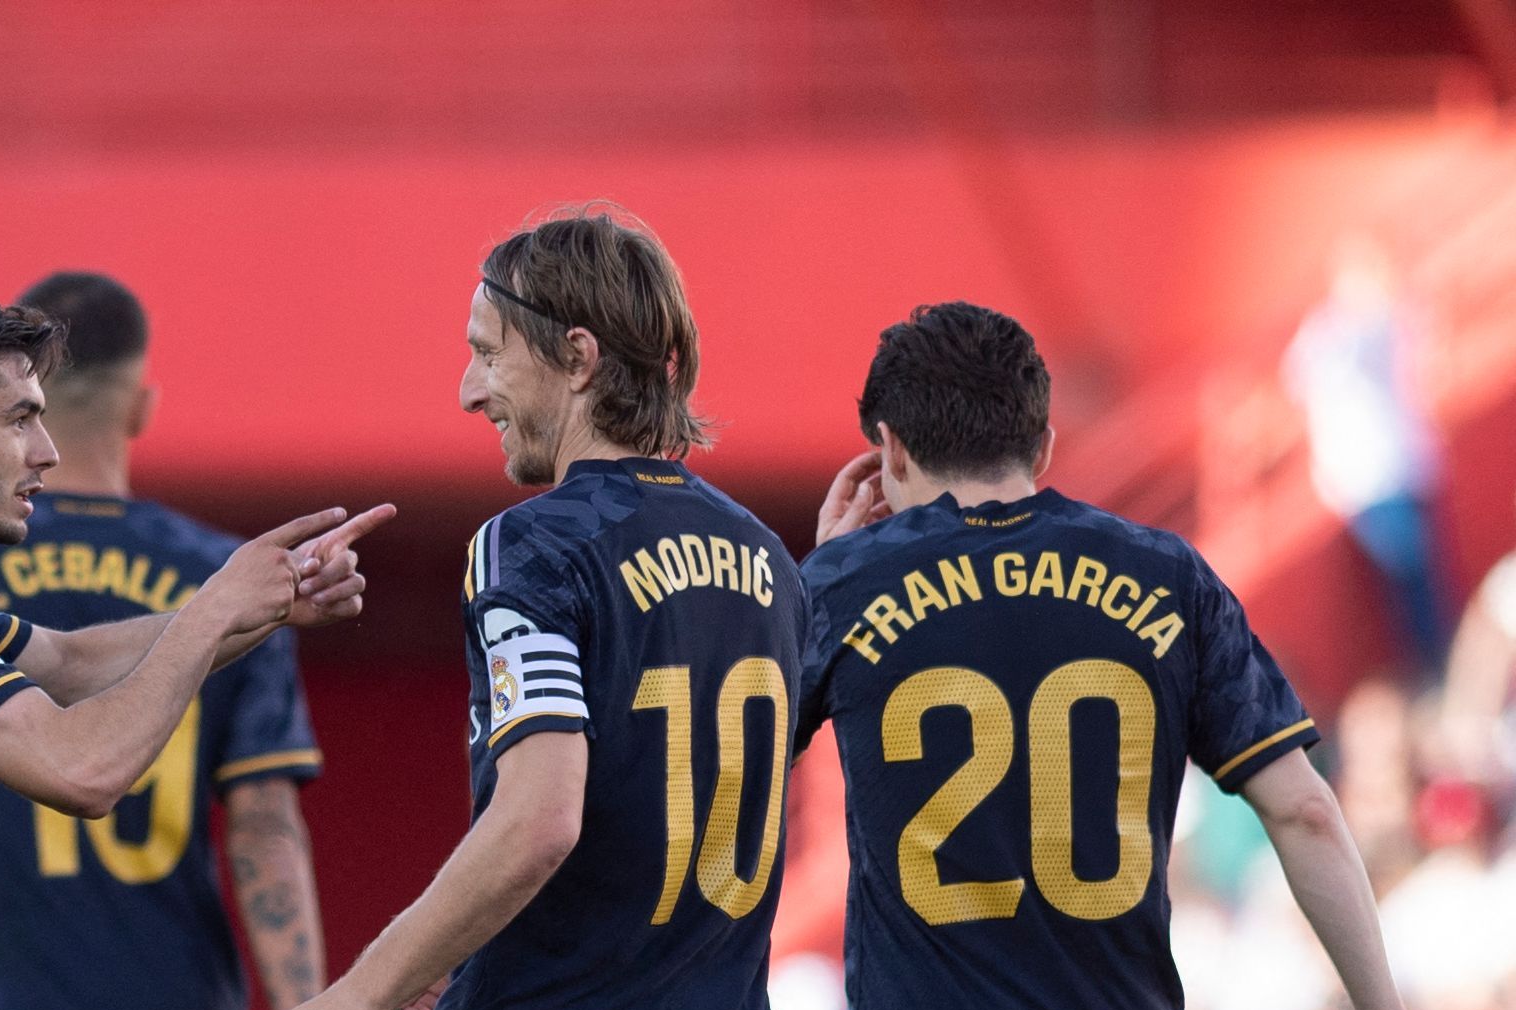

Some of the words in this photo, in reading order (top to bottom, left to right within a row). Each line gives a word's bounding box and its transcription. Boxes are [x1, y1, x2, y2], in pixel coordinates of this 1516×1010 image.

[619, 533, 774, 613] MODRIĆ
[842, 554, 983, 665] FRAN
[992, 551, 1186, 660] GARCÍA
[631, 656, 788, 926] 10
[881, 658, 1157, 927] 20
